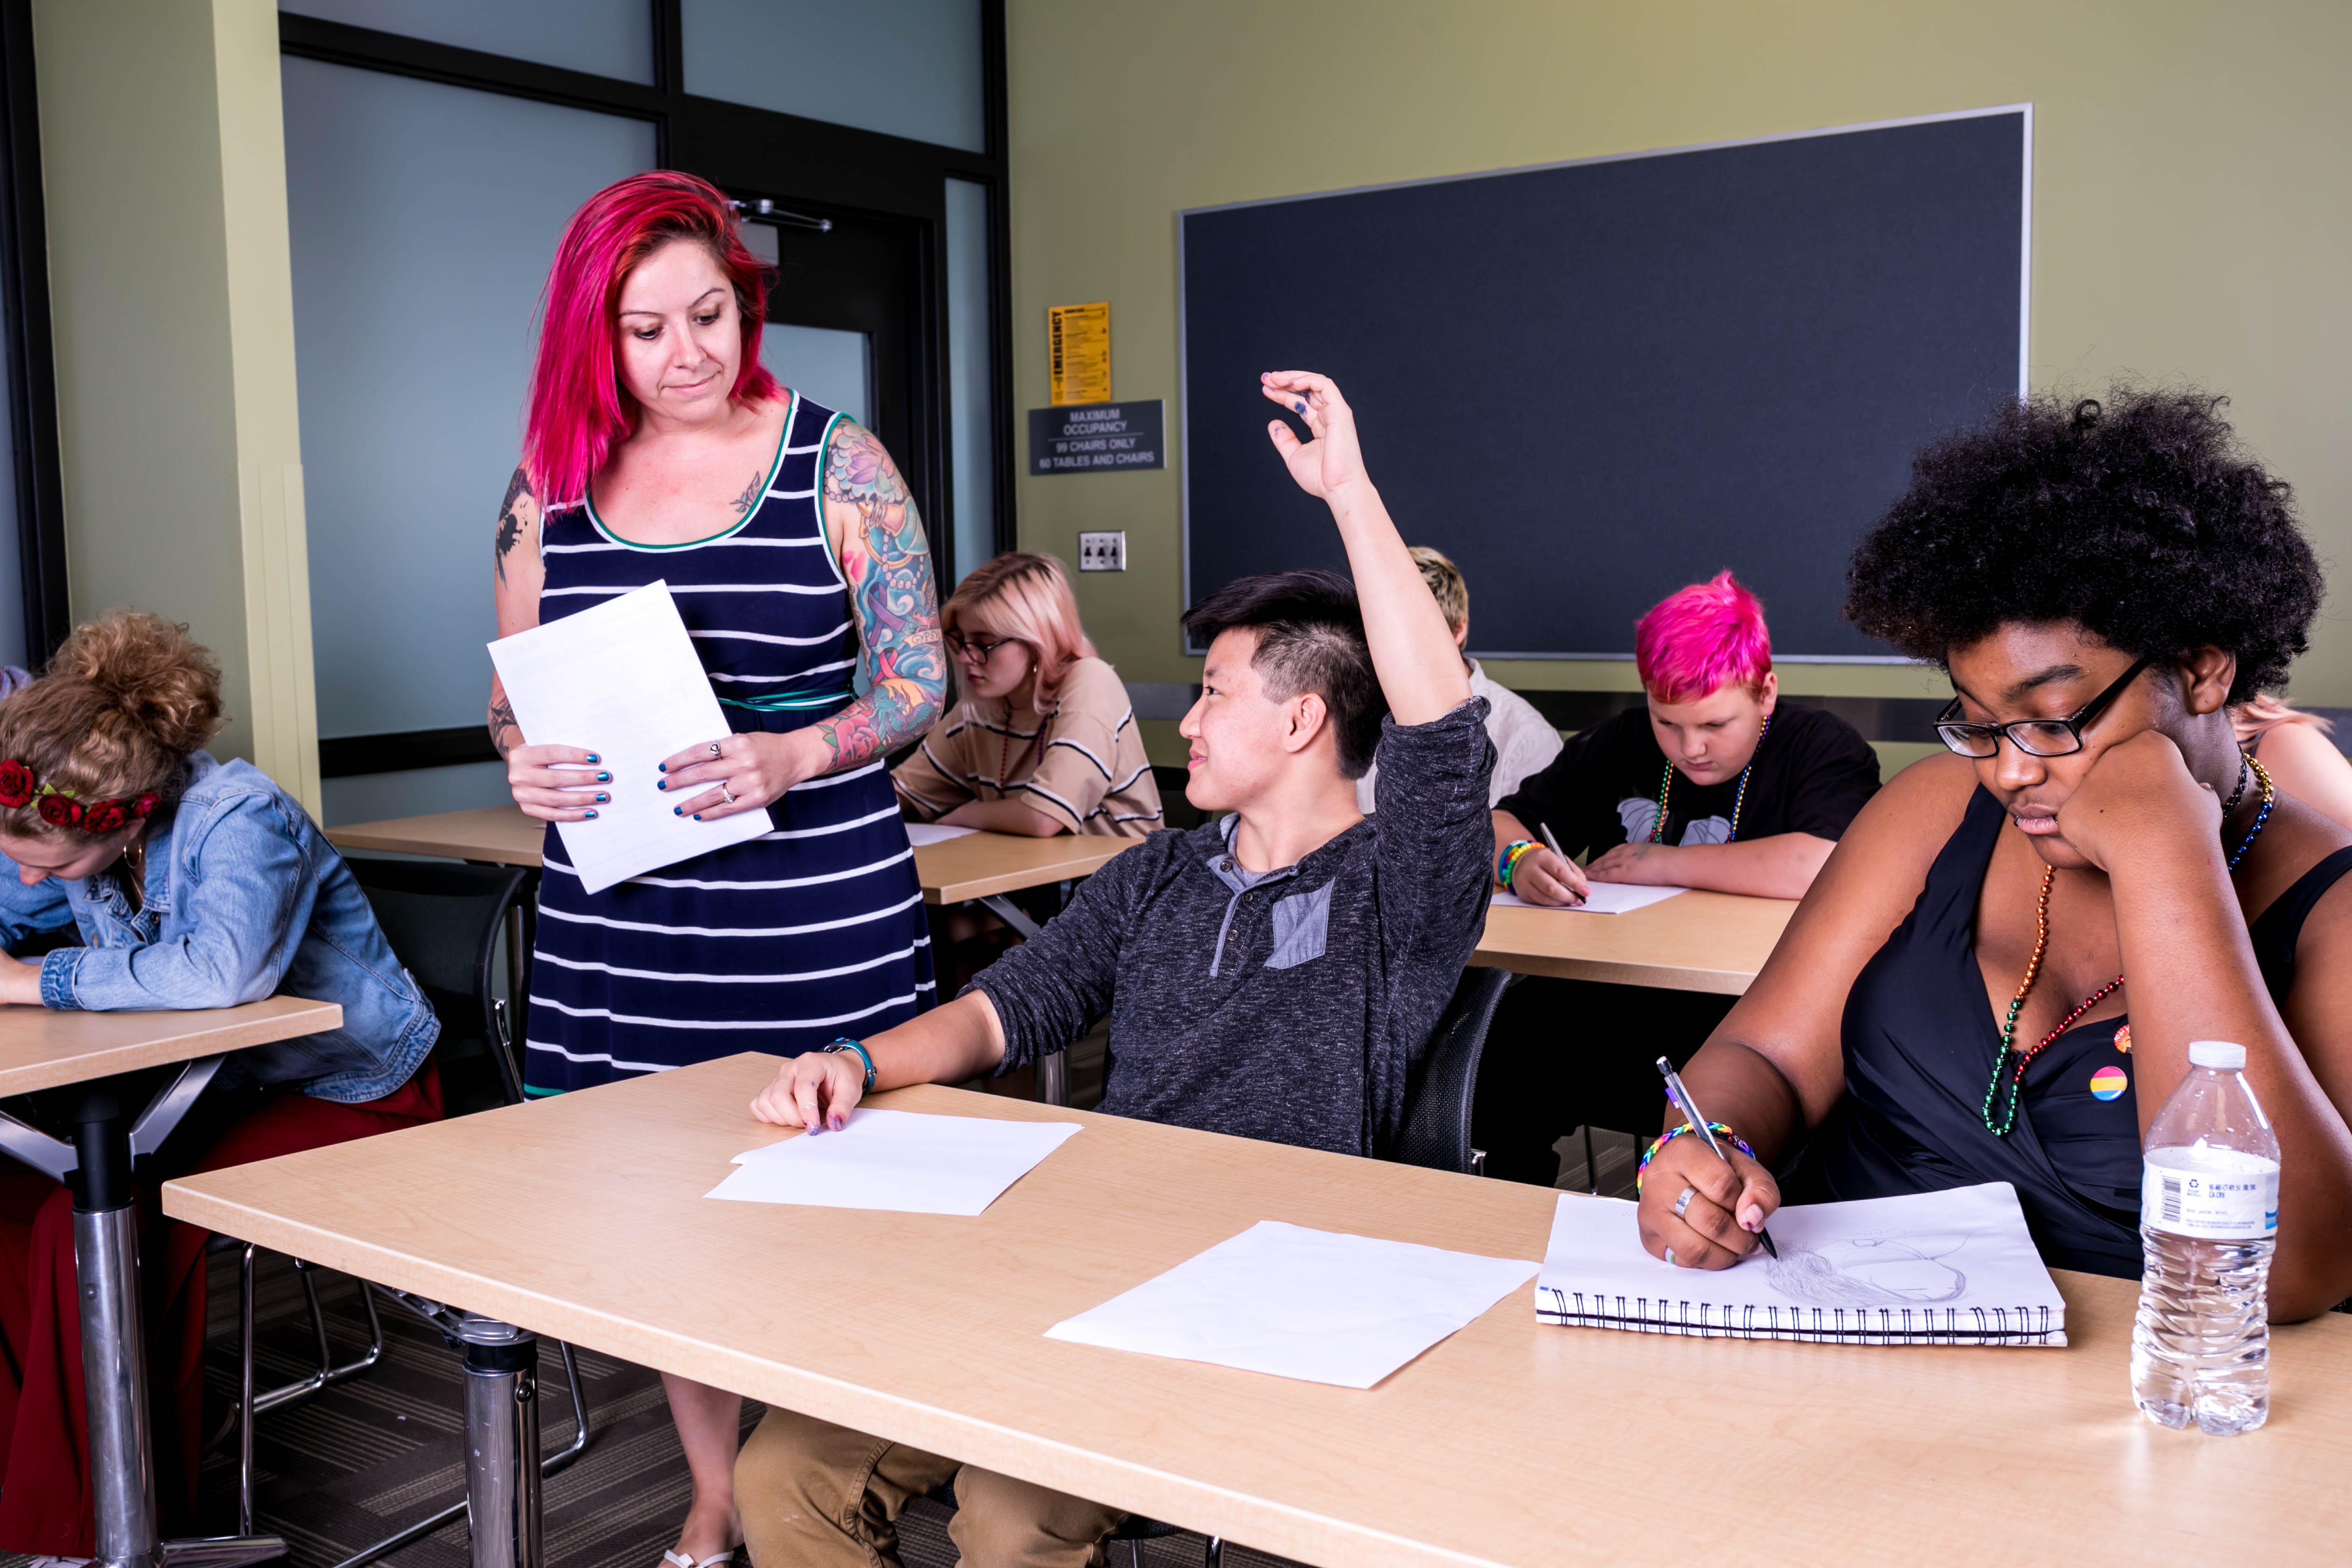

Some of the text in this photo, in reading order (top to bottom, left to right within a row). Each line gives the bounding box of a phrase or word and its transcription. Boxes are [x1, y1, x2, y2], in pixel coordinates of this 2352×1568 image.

[1052, 311, 1063, 375] EMERGENCY
[1070, 409, 1120, 422] MAXIMUM
[1063, 421, 1127, 435] OCCUPANCY
[1070, 439, 1107, 452] CHAIRS
[1109, 437, 1136, 449] ONLY
[1053, 455, 1090, 468] TABLES
[1092, 454, 1114, 465] AND
[1116, 451, 1155, 464] CHAIRS
